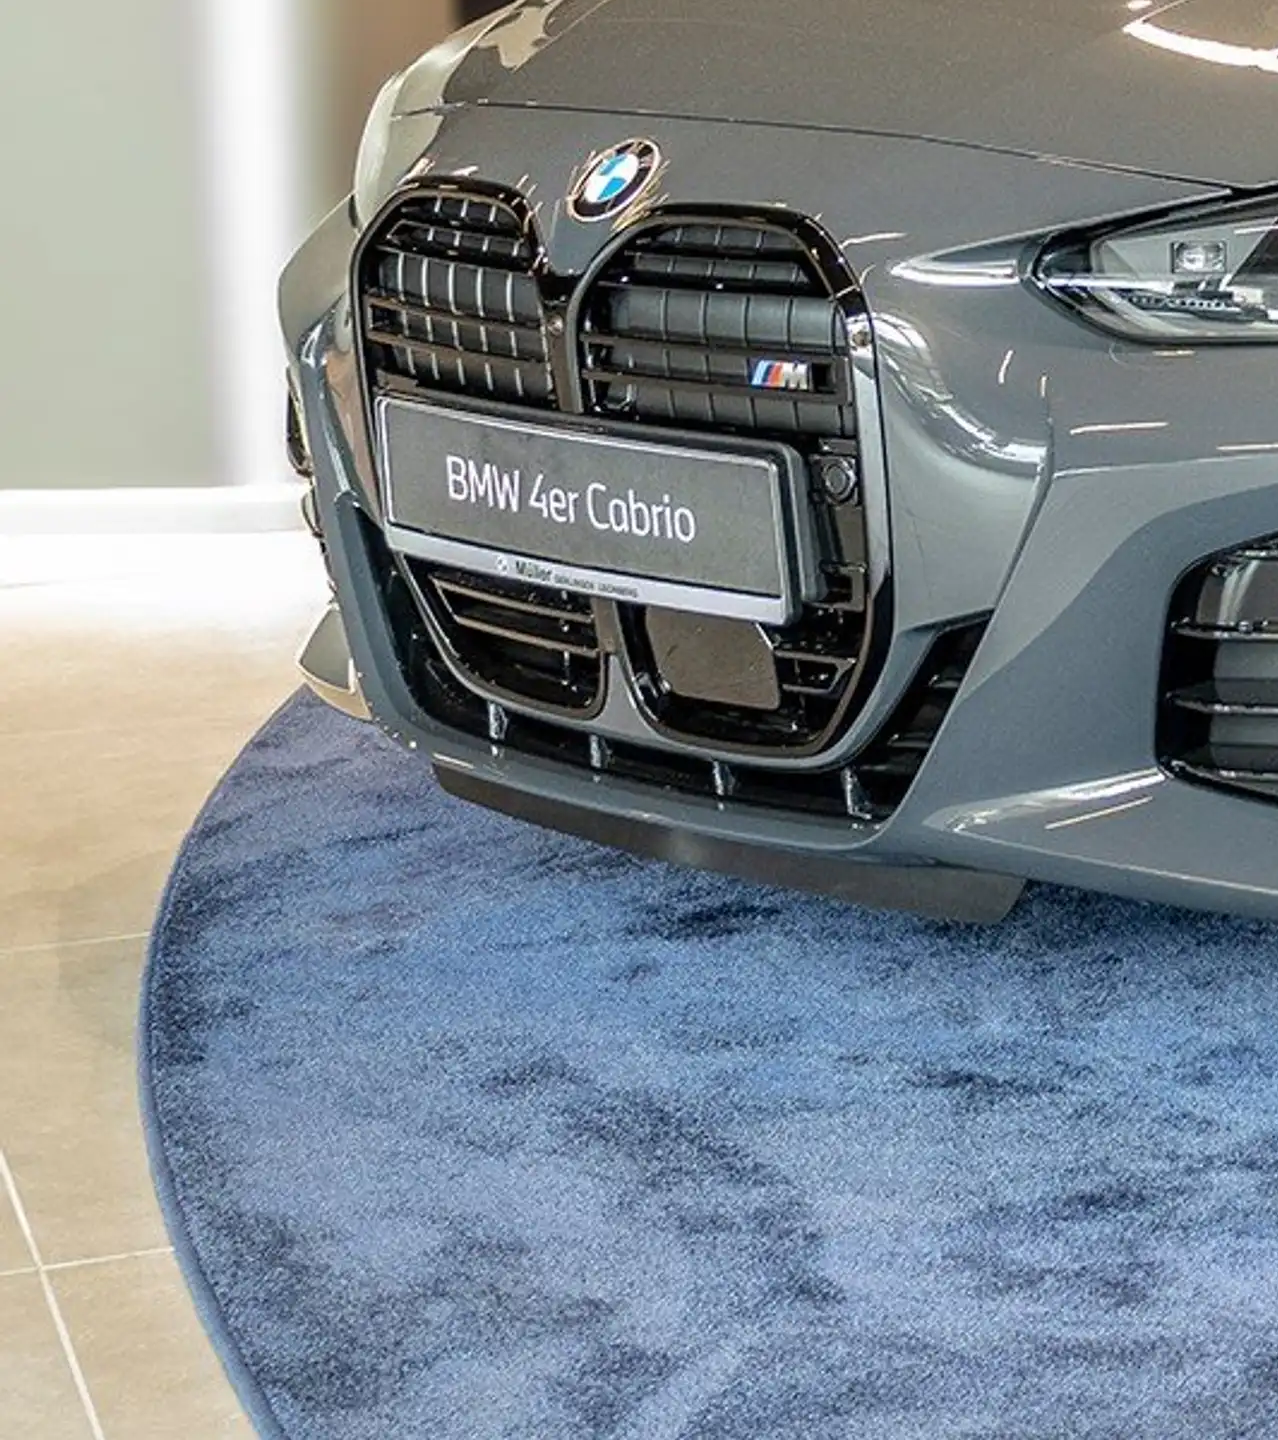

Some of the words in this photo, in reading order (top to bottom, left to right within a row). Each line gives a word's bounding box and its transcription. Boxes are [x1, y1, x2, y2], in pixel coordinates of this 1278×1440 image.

[446, 454, 520, 513] BMW
[529, 473, 579, 524] 4er
[586, 482, 696, 544] Cabrio
